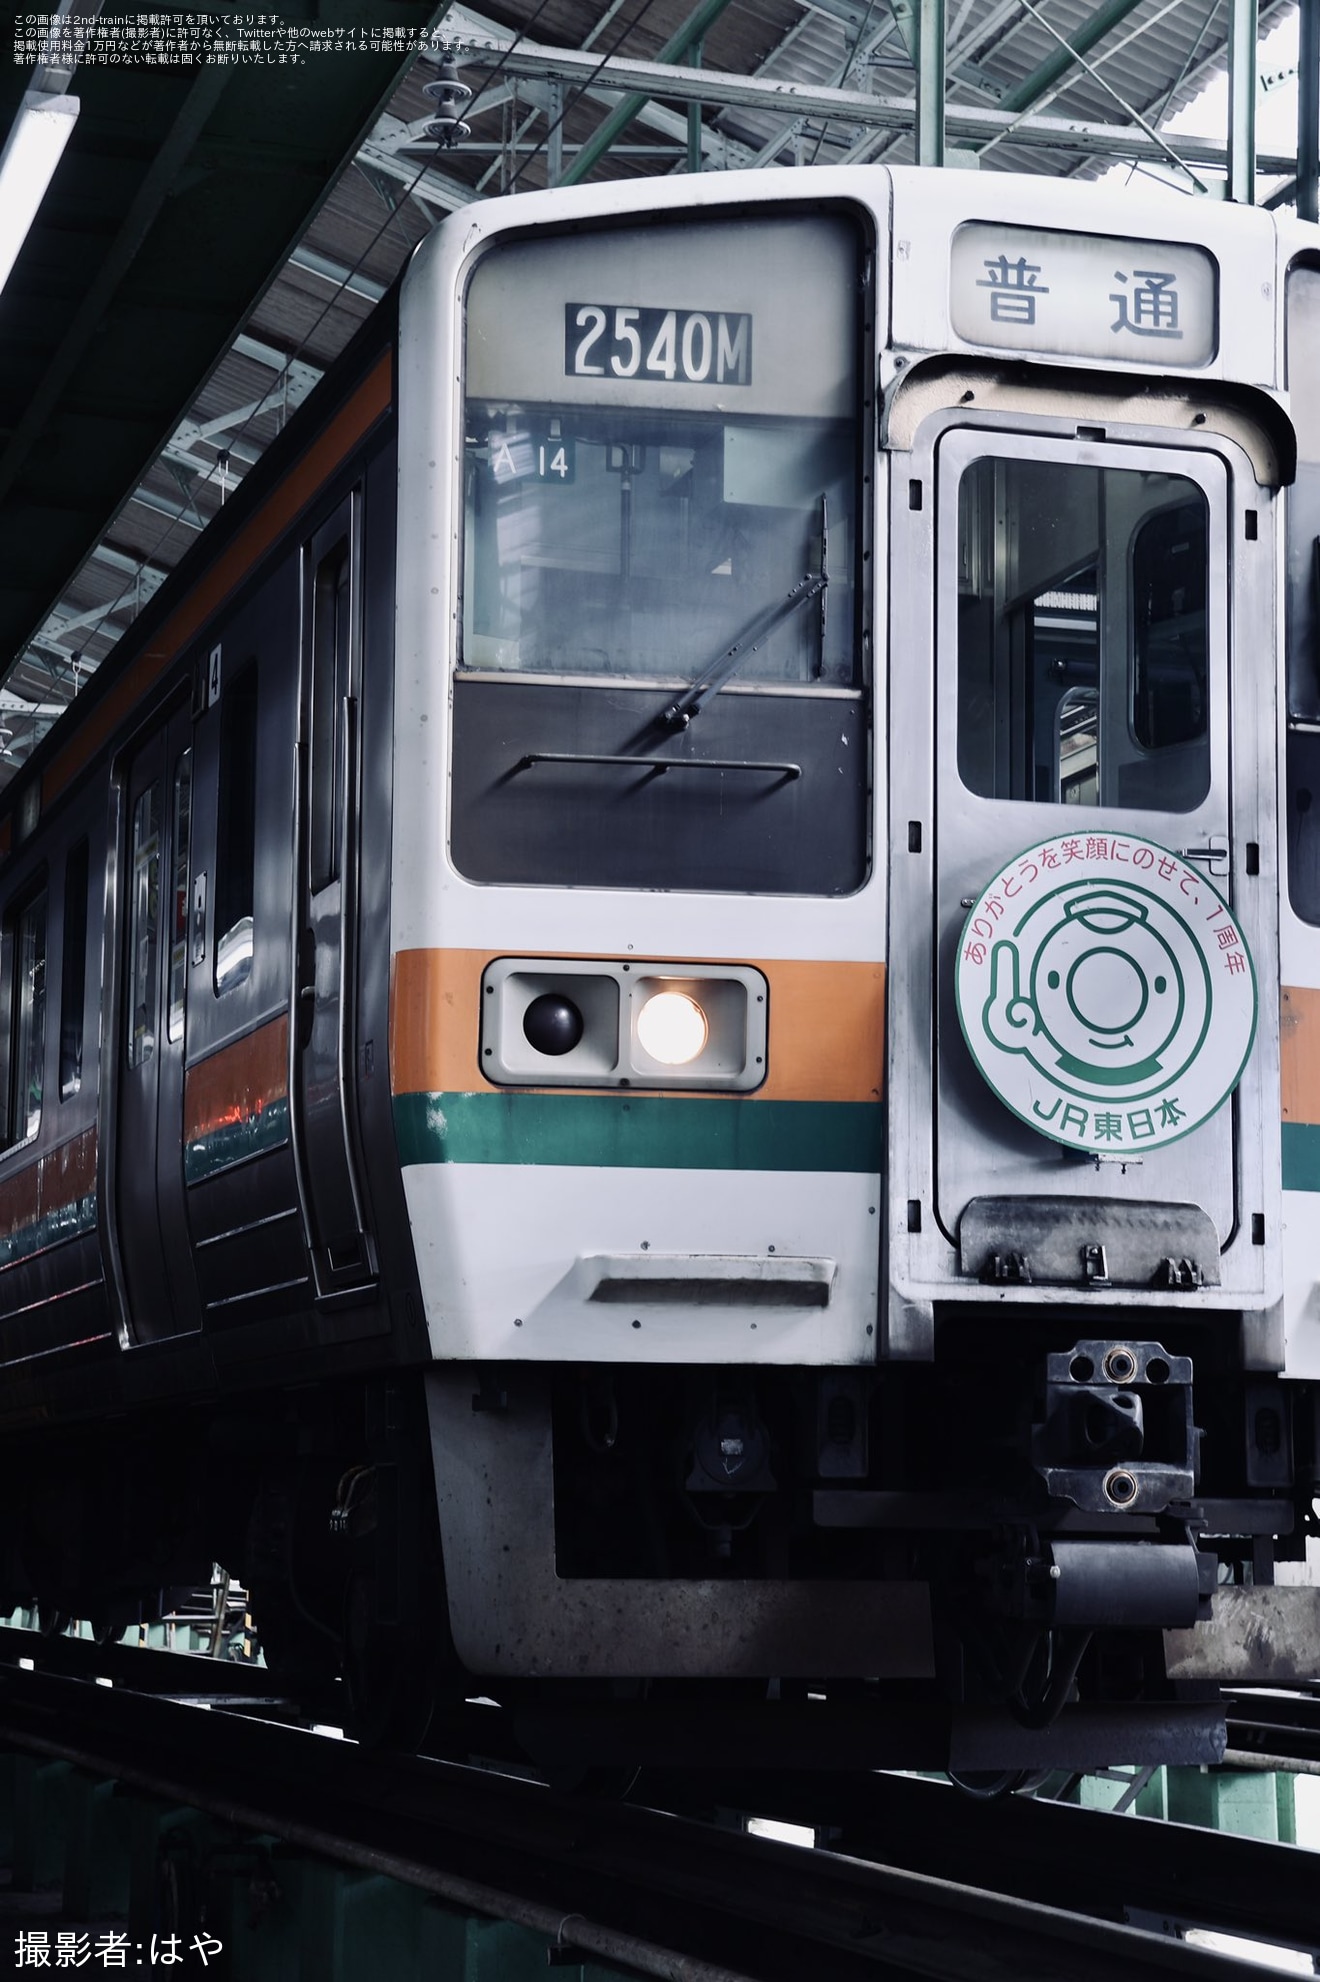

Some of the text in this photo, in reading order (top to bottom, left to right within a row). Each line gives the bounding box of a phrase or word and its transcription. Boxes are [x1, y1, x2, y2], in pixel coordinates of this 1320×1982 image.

[975, 254, 1183, 340] 普通
[573, 305, 749, 384] 2540M
[493, 442, 569, 478] A 14
[1032, 1096, 1187, 1142] JR東日本
